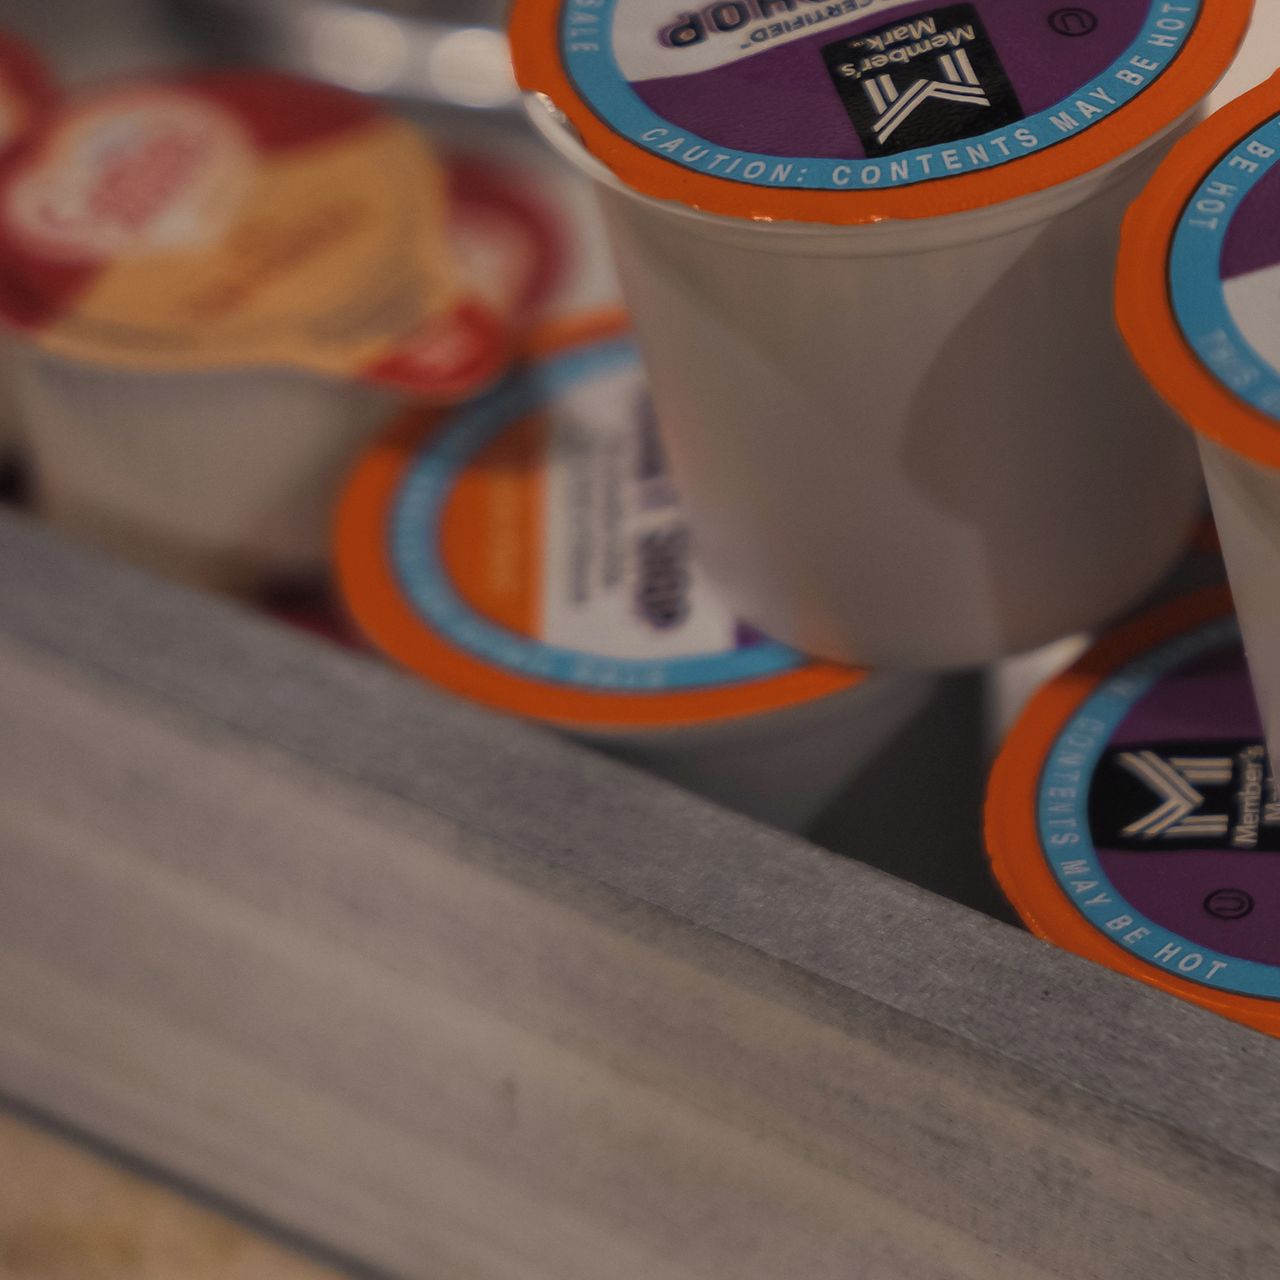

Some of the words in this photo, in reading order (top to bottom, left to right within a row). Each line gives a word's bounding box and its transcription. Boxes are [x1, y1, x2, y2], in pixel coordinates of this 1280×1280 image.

[841, 23, 976, 78] Member's
[640, 127, 808, 182] CAUTION:
[832, 127, 1039, 185] CONTENTS
[1049, 87, 1117, 132] MAY
[1116, 55, 1160, 86] BE
[1148, 3, 1191, 47] HOT
[1228, 140, 1276, 173] BE
[1189, 181, 1237, 231] HOT
[1047, 717, 1105, 845] CONTENTS
[1232, 745, 1265, 847] Member's
[1060, 859, 1112, 907] MAY
[1105, 914, 1152, 944] BE
[1153, 941, 1228, 980] HOT
